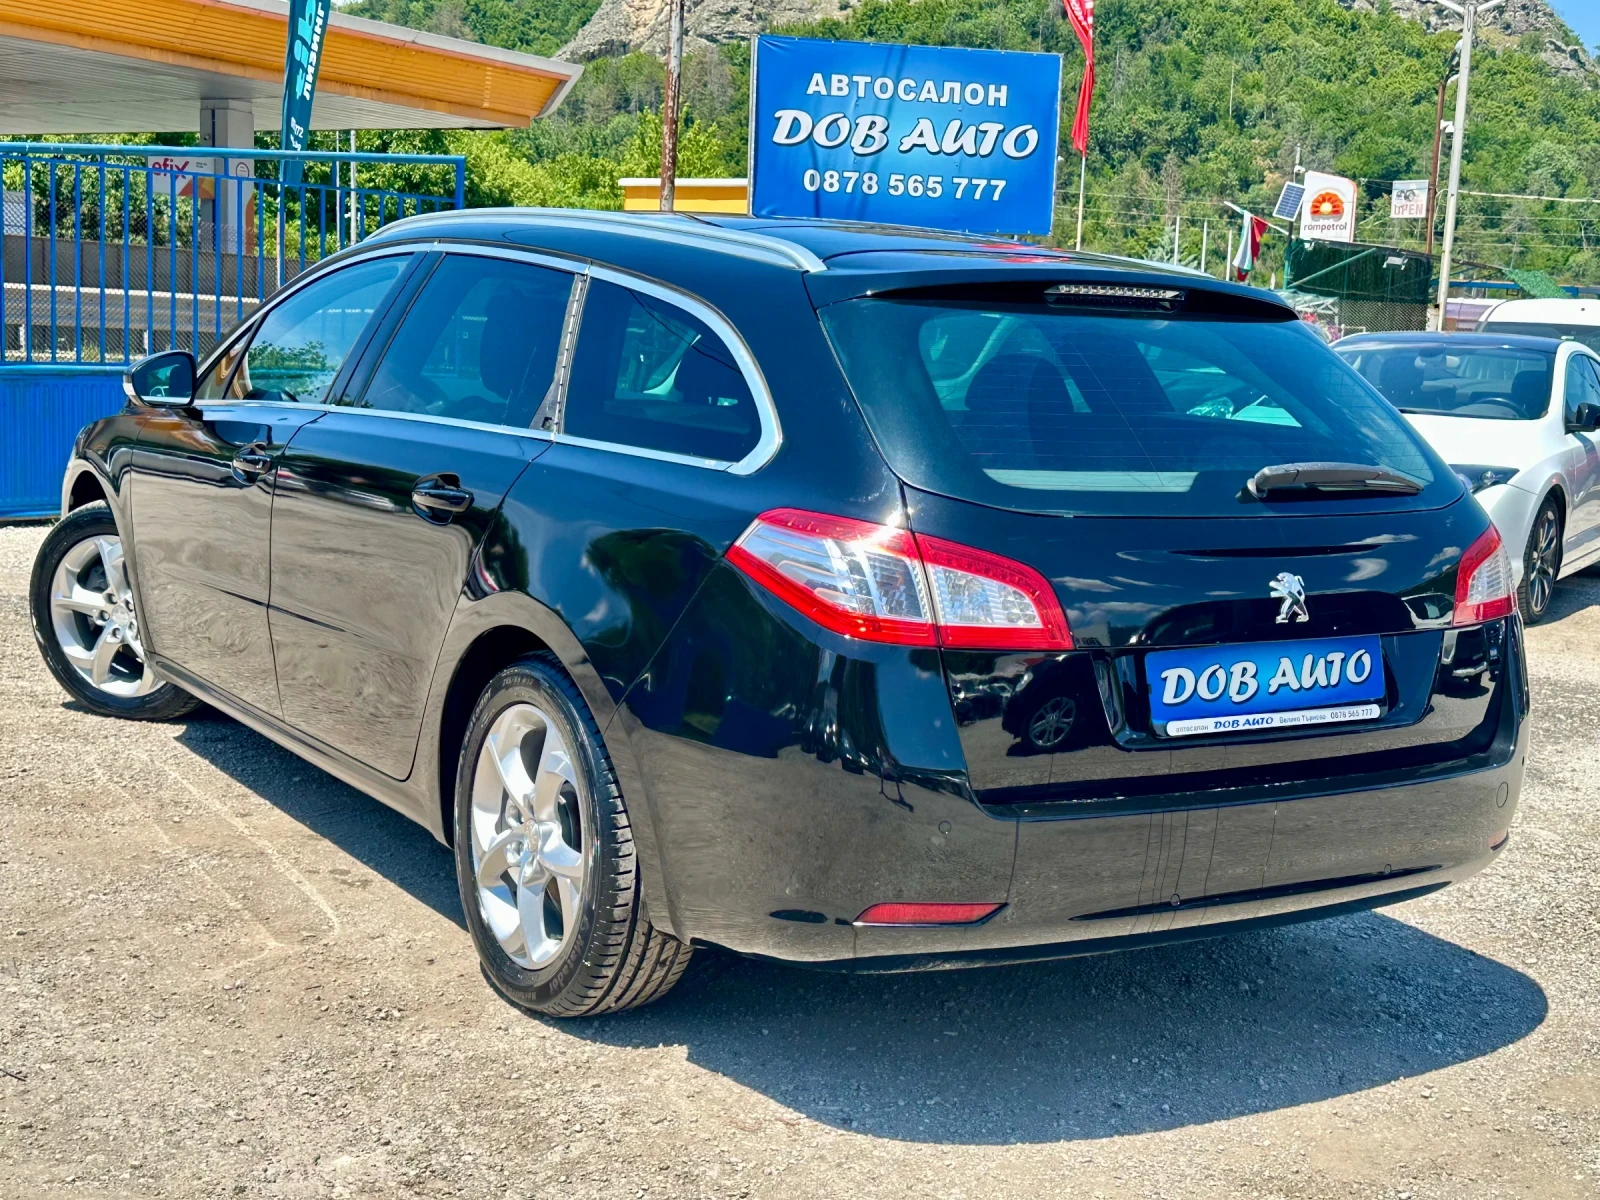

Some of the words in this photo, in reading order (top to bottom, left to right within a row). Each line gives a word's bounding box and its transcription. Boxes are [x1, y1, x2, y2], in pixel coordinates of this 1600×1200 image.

[806, 72, 1008, 107] АВТОСАЛОН
[772, 109, 889, 155] DOB
[899, 117, 1039, 159] AUTO
[803, 169, 879, 195] 0878
[887, 173, 943, 198] 565
[952, 177, 1007, 201] 777
[1394, 203, 1424, 216] OPEN
[1303, 222, 1348, 233] rompetrol
[1160, 661, 1259, 705] DOB
[1268, 649, 1372, 695] AUTO
[1213, 720, 1240, 730] DOB
[1242, 717, 1274, 727] AUTO
[1361, 708, 1373, 717] 777
